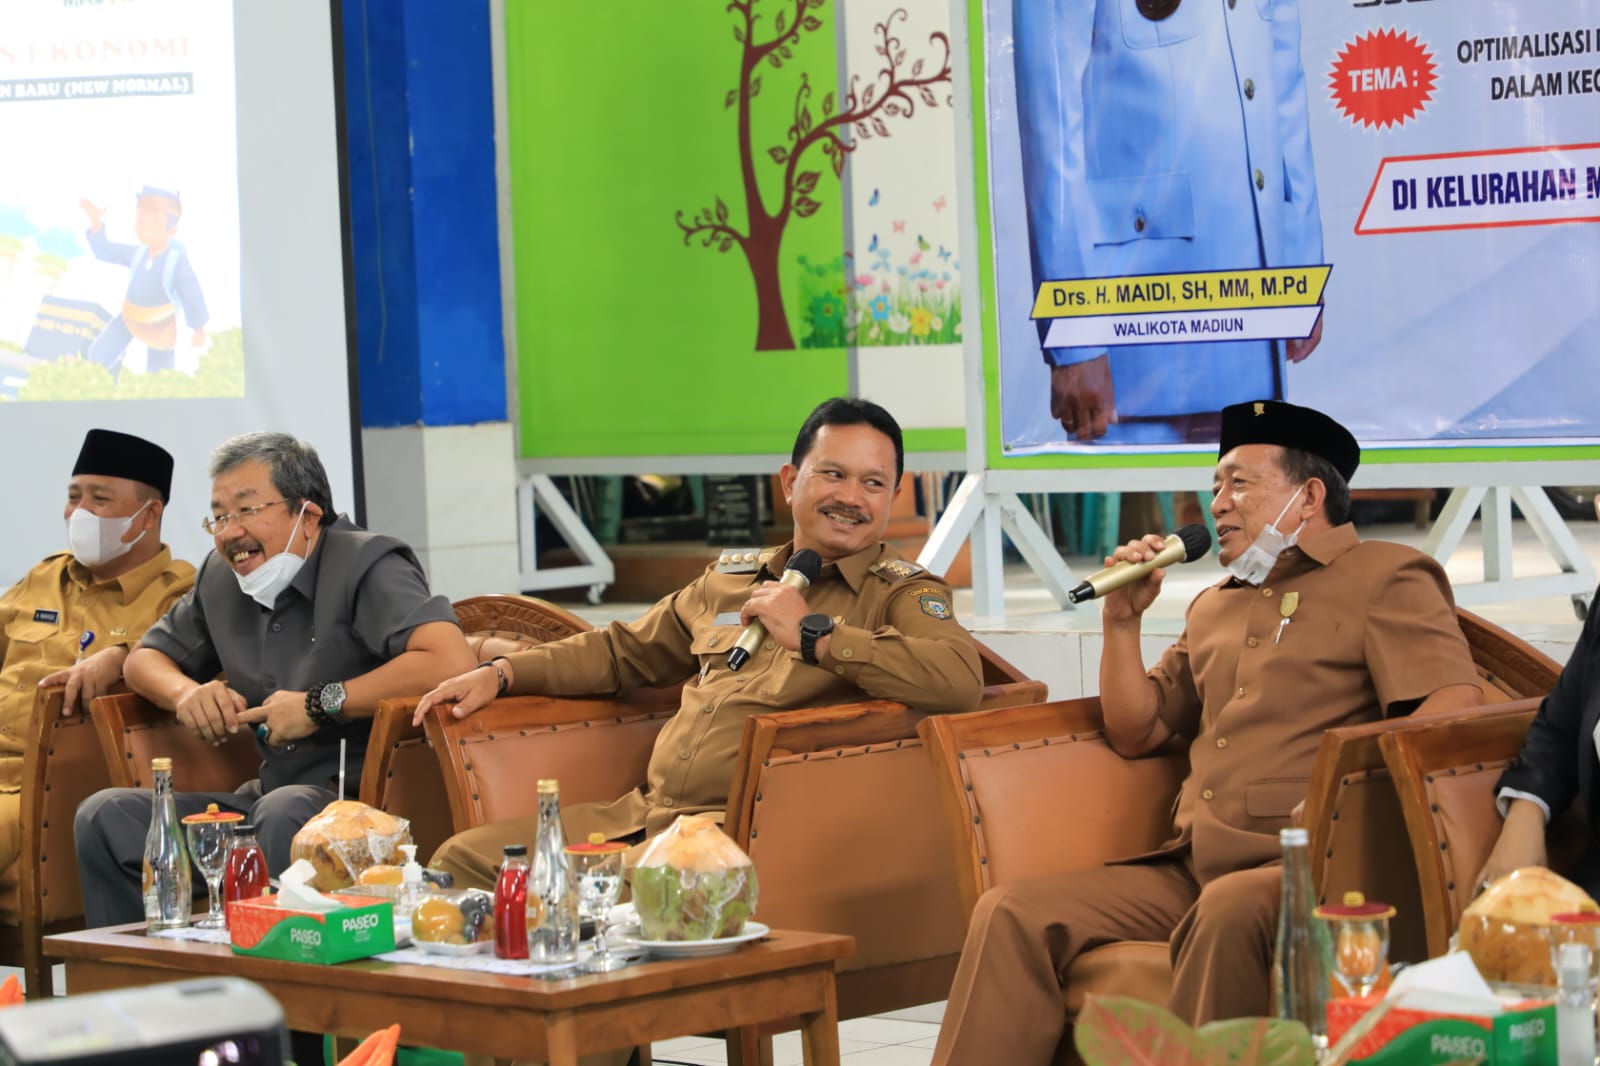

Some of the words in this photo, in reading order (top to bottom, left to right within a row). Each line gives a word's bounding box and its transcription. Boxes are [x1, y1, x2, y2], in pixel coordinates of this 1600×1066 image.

[1457, 29, 1591, 64] OPTIMALISASI
[14, 82, 61, 98] BARU
[64, 80, 110, 97] (NEW
[112, 77, 190, 94] NORMAL)
[1348, 65, 1407, 92] TEMA
[1491, 72, 1562, 100] DALAM
[1392, 178, 1417, 211] DI
[1427, 168, 1576, 208] KELURAHAN
[1053, 288, 1091, 307] Drs.
[1096, 286, 1111, 304] H.
[1116, 282, 1176, 305] MAIDI,
[1182, 280, 1213, 303] SH,
[1219, 278, 1254, 300] MM,
[1261, 275, 1308, 297] M.Pd
[1113, 320, 1187, 337] WALIKOTA
[1190, 318, 1244, 333] MADIUN
[342, 913, 379, 933] PASEO
[290, 927, 322, 946] PASEO
[1509, 1018, 1546, 1041] PASEO
[1431, 1034, 1485, 1057] PASEO
